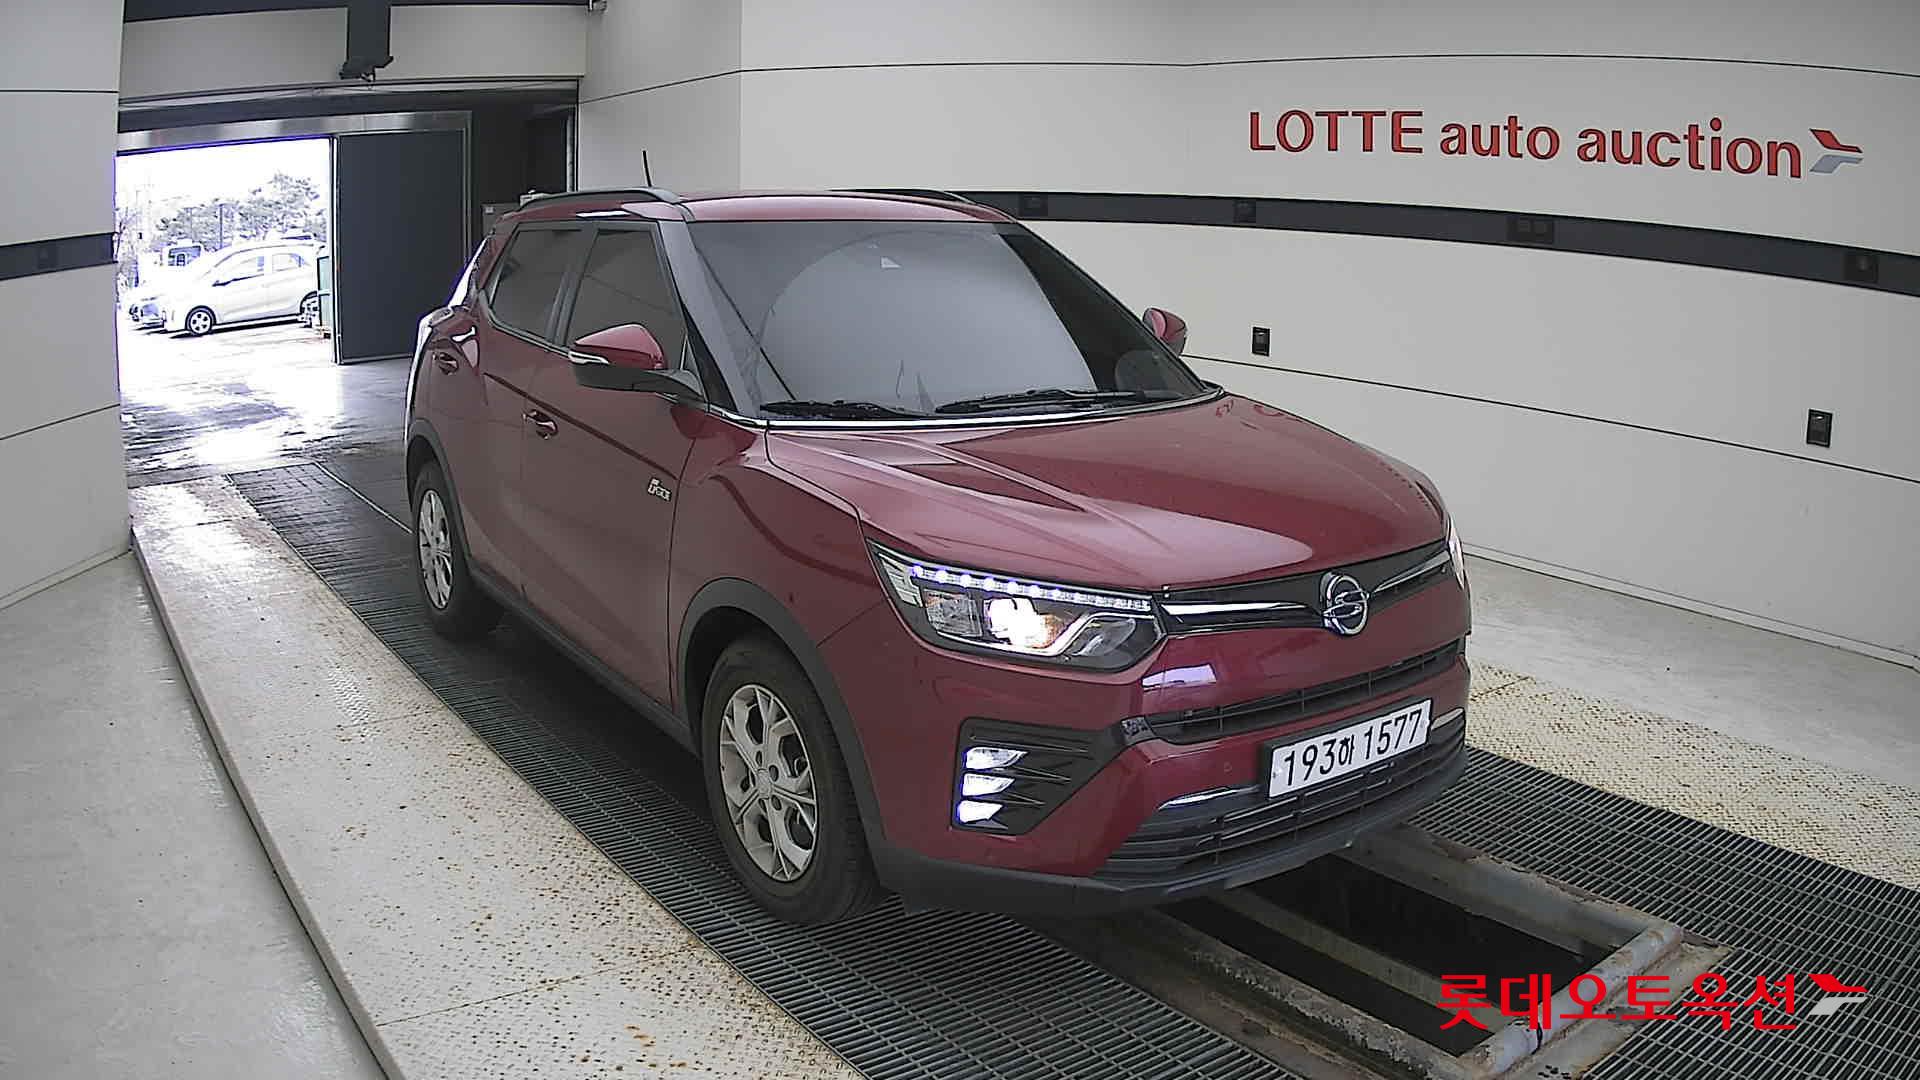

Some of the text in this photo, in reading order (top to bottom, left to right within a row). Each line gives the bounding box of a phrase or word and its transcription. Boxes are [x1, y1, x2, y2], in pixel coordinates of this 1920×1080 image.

[1249, 110, 1802, 179] LOTTE auto auction
[1284, 709, 1422, 786] 193하 1577
